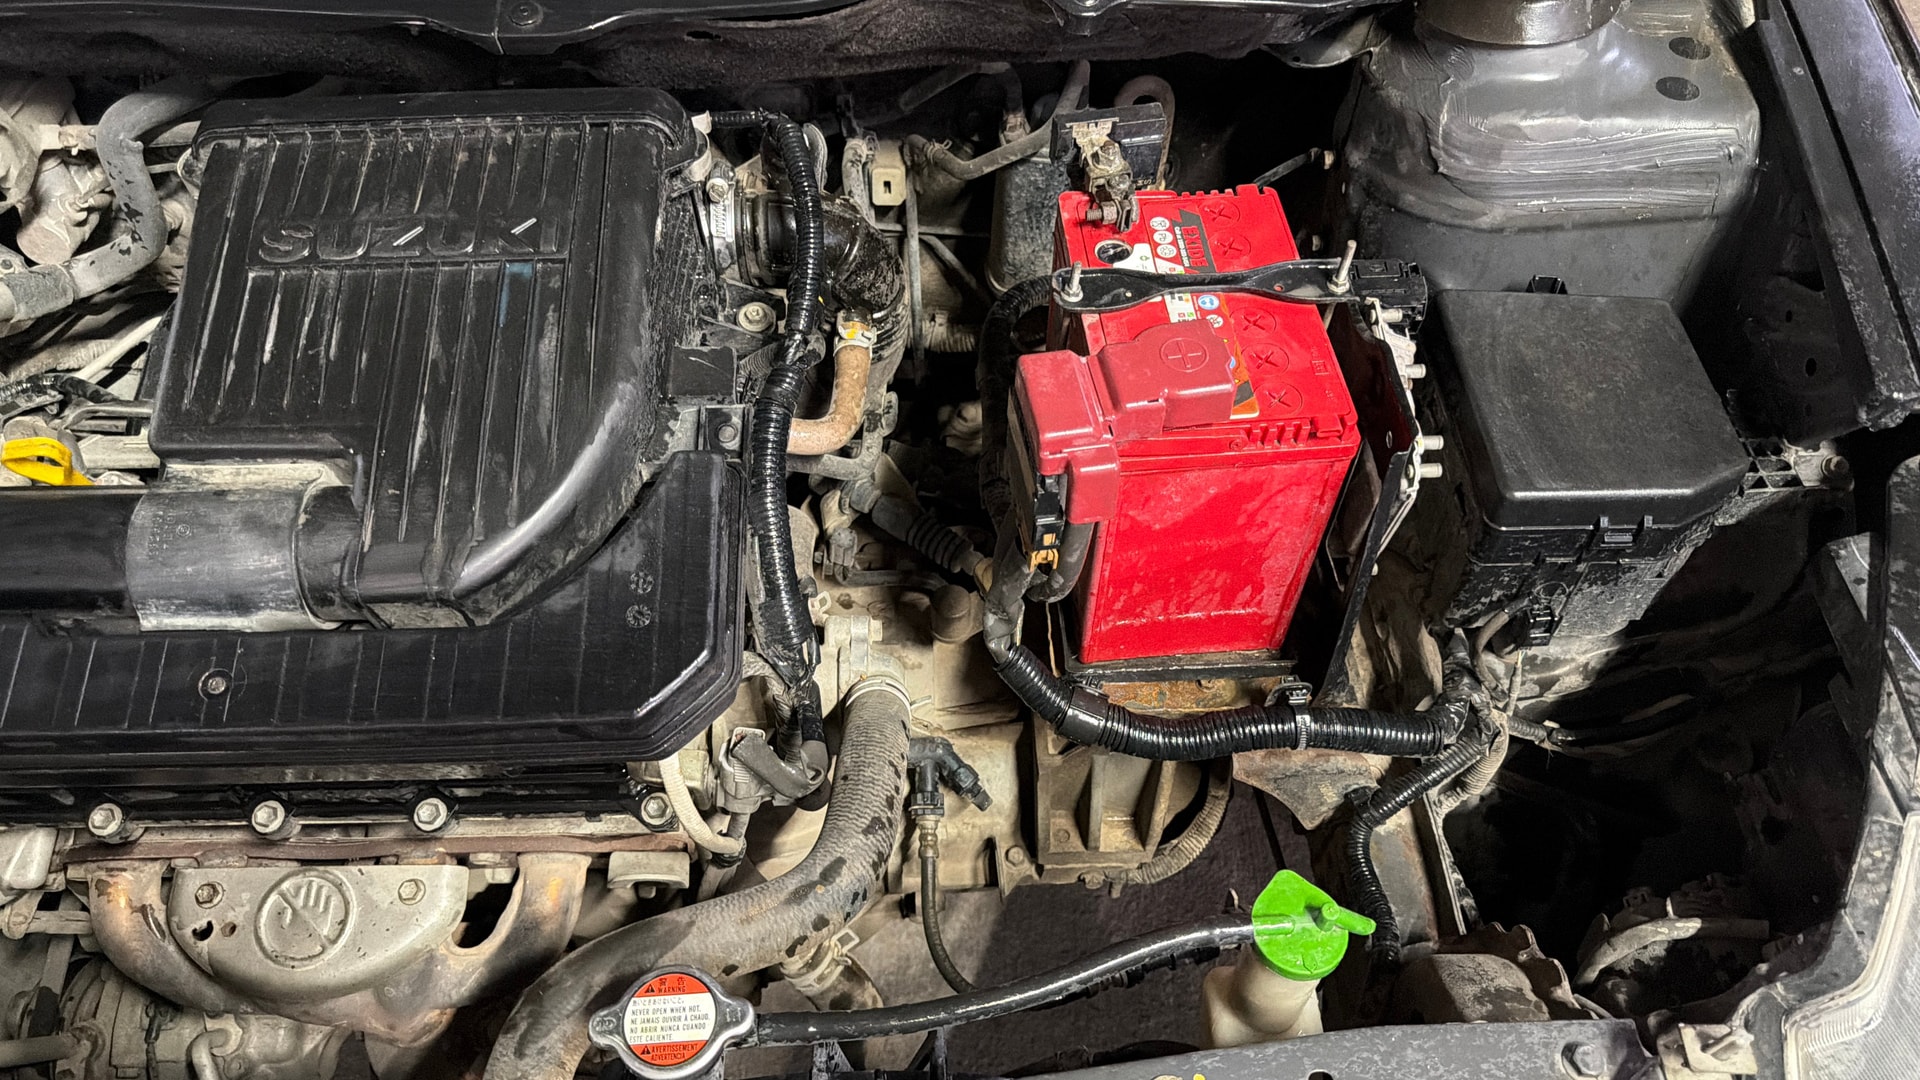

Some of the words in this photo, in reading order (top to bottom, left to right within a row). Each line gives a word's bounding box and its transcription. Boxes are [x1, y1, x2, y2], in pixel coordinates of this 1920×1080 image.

[257, 217, 560, 263] SUZUKI
[1181, 226, 1208, 267] EXIDE
[658, 986, 686, 994] WARNING
[631, 1008, 650, 1016] NEVER
[652, 1007, 667, 1015] OPEN
[670, 1006, 686, 1014] WHEN
[688, 1005, 702, 1013] HOT.
[640, 1016, 660, 1024] JAMAIS
[661, 1015, 682, 1023] OUVRIR
[660, 1024, 680, 1032] NUNCA
[682, 1022, 706, 1031] CUANDO
[629, 1035, 643, 1043] ESTE
[651, 1043, 698, 1053] AVERTISSEMENT
[650, 1052, 686, 1061] ADVERTENCIA
